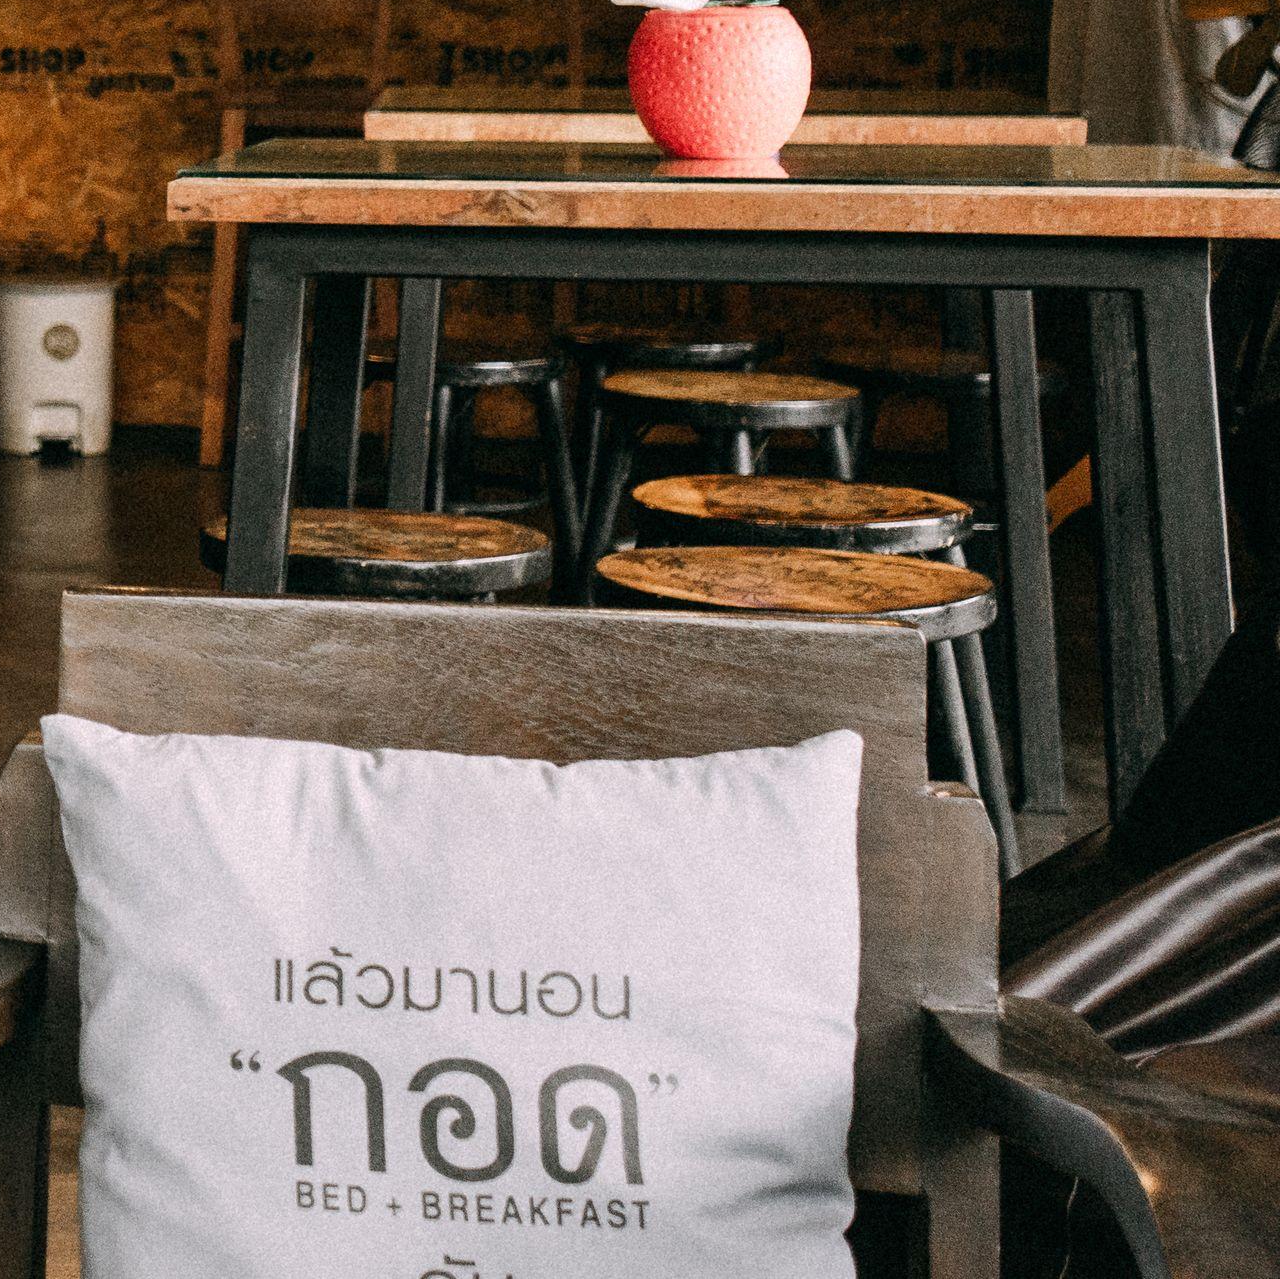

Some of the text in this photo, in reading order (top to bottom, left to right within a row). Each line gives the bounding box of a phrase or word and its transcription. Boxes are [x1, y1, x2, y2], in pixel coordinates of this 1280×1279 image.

[272, 946, 632, 1020] แล้วมานอน
[295, 1179, 368, 1214] BED
[420, 1190, 652, 1231] BREAKFAST
